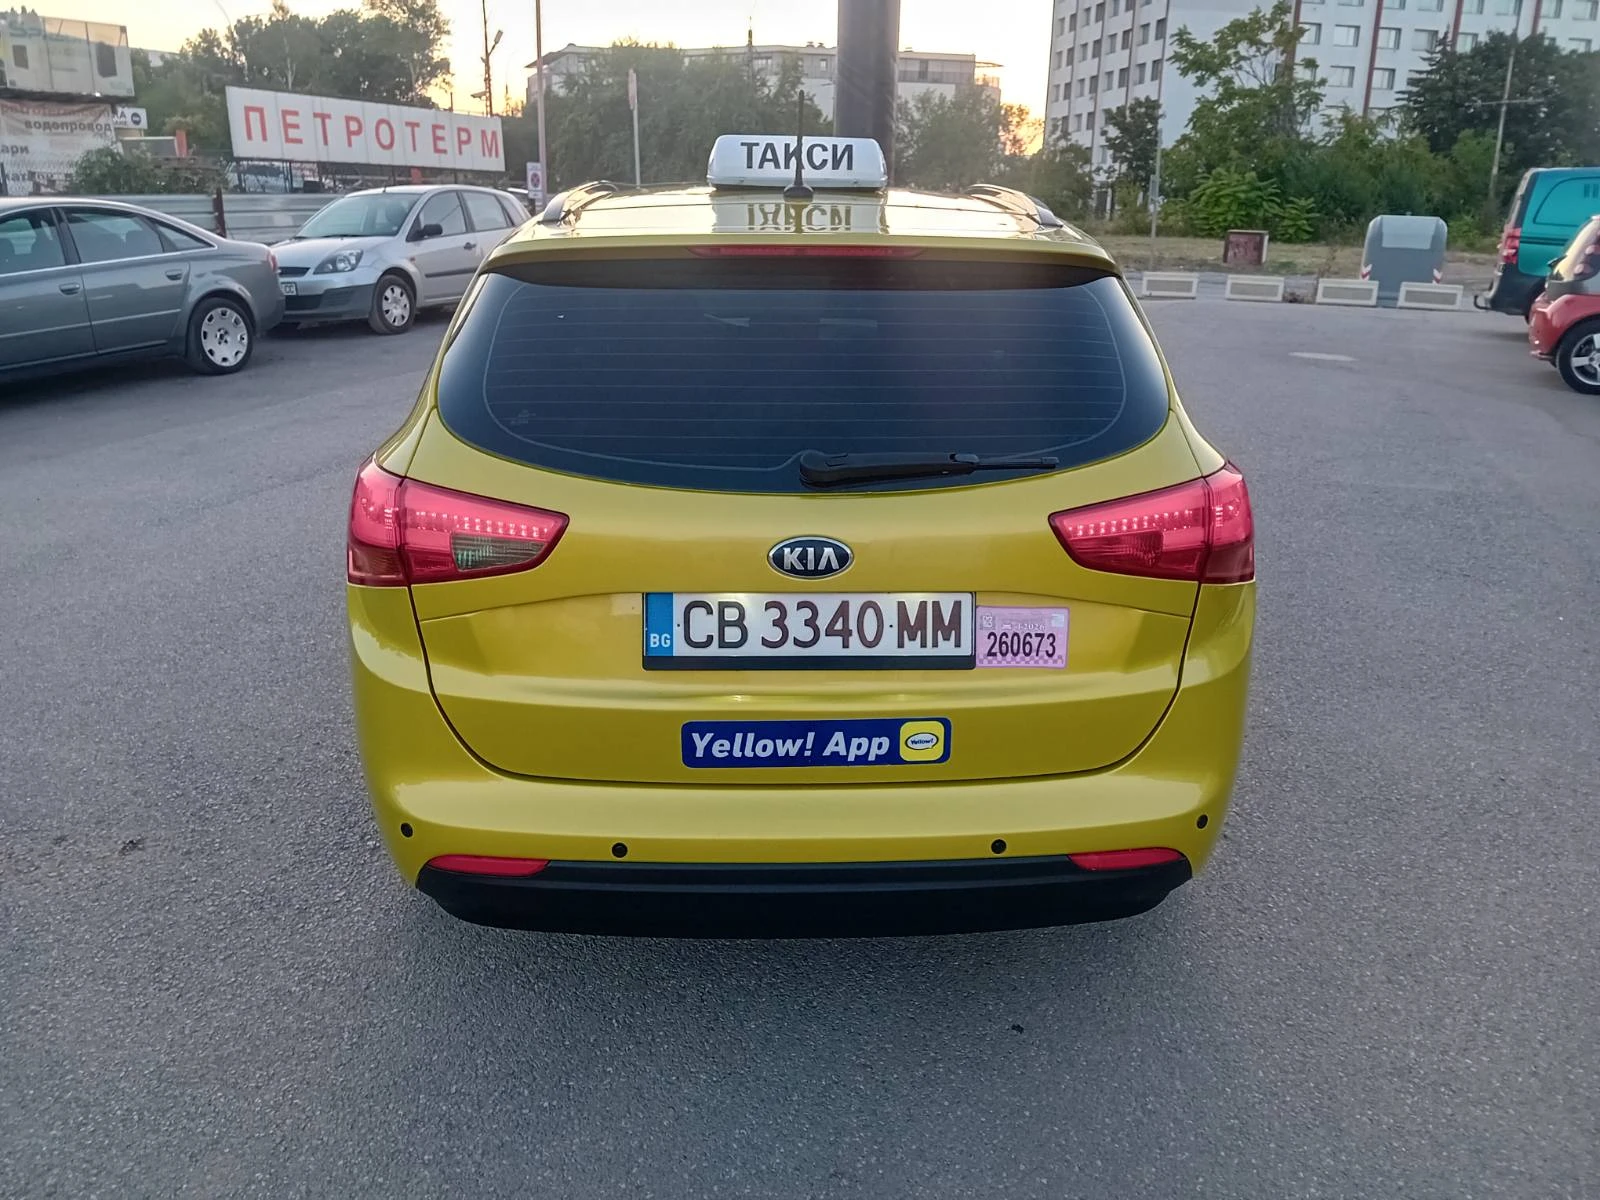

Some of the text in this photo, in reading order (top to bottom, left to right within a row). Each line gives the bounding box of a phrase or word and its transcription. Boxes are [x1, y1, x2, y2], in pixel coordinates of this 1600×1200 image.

[24, 120, 112, 133] водопровод
[244, 104, 499, 158] ПЕТРОТЕРМ
[740, 142, 853, 171] ТАКСИ
[783, 547, 840, 570] KIA
[683, 600, 961, 649] CB 3340 MM
[650, 633, 671, 647] BG
[986, 631, 1056, 657] 260673
[691, 731, 890, 762] Yellow! App
